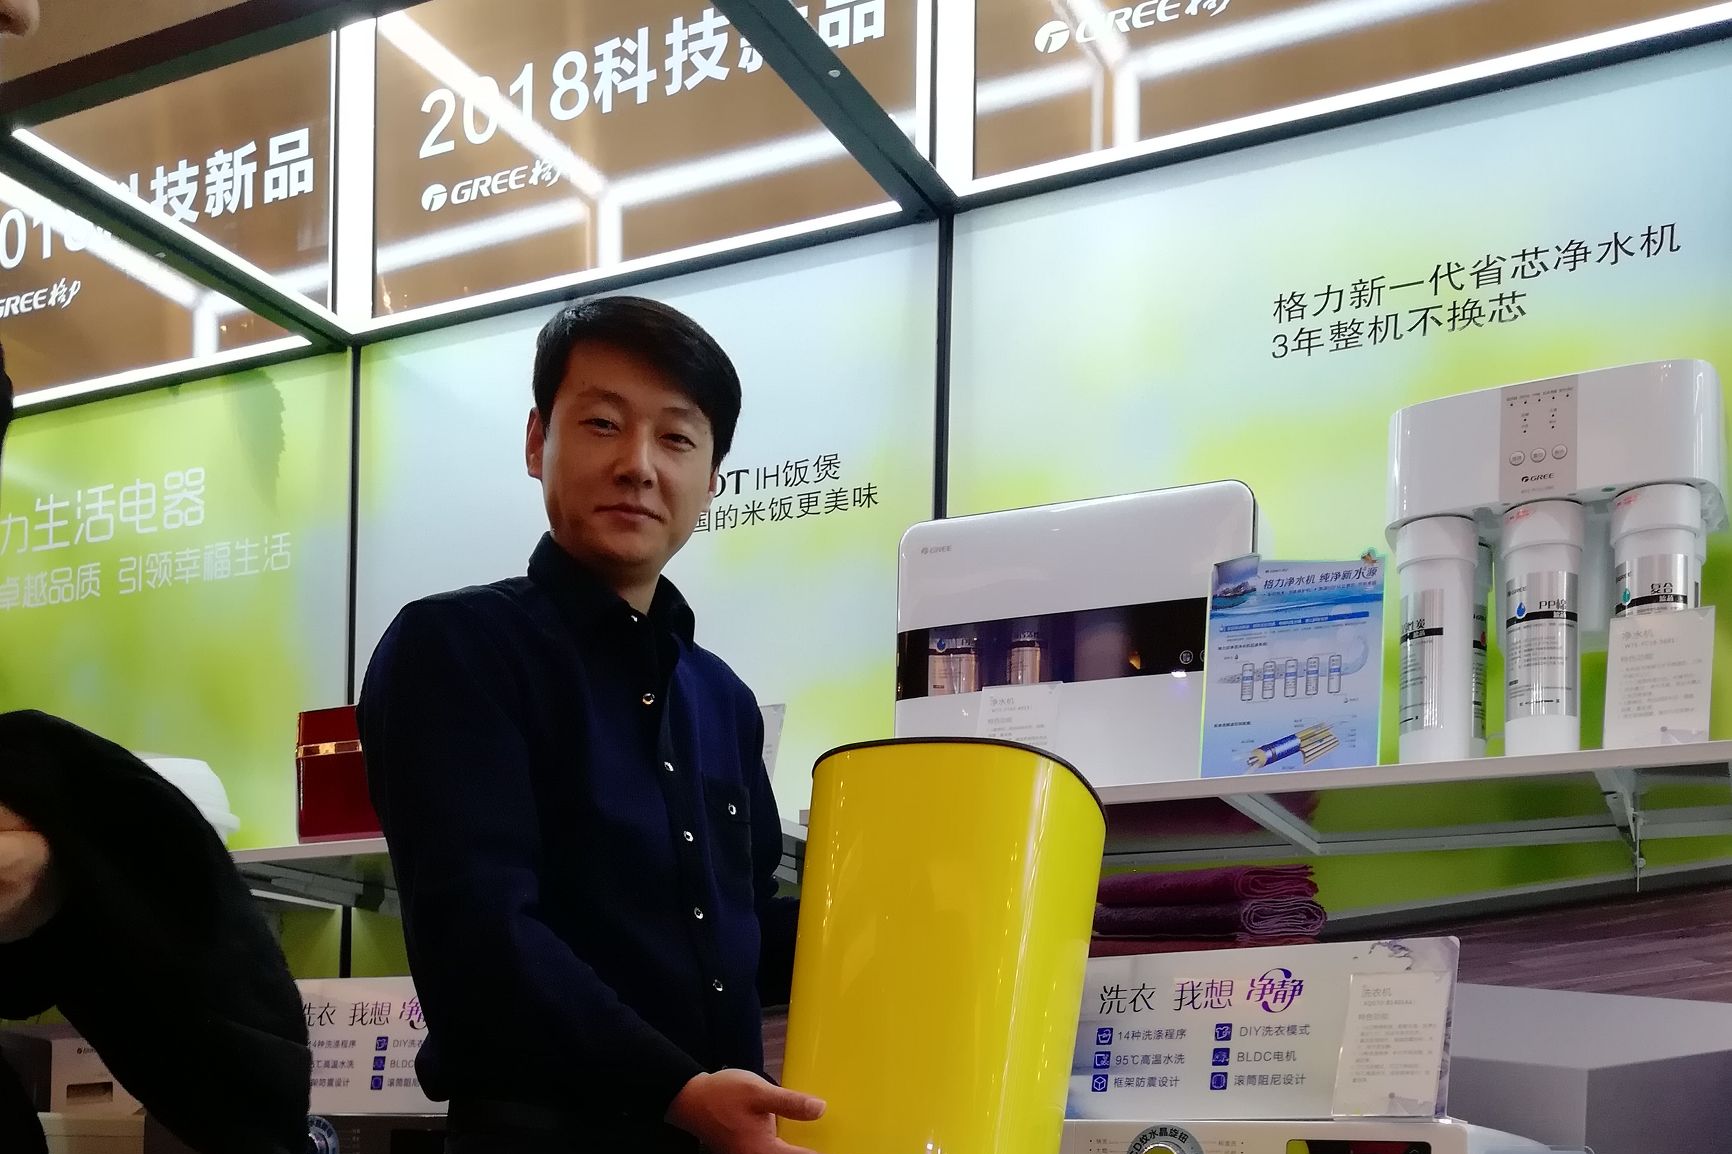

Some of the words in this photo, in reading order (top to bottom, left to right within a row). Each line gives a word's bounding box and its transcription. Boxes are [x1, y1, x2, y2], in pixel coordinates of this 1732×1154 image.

[419, 0, 885, 159] 2018科技品
[450, 164, 527, 206] GREE
[1273, 222, 1682, 324] 格力新一代省芯净水机
[1271, 290, 1527, 359] 3年整机不换芯
[0, 467, 206, 554] 力生活电器
[0, 562, 101, 611] 卓越品质
[118, 532, 291, 594] 引领幸福生活
[1263, 574, 1316, 590] 格力净水机
[1099, 983, 1156, 1014] 洗衣
[1173, 979, 1234, 1011] 我想
[1246, 967, 1304, 1014] 净静
[349, 1001, 391, 1026] 我想
[1117, 1028, 1187, 1041] 14种洗涤程序
[1239, 1024, 1311, 1038] DIY洗衣模式
[1115, 1054, 1185, 1066] 95℃高温水洗
[1236, 1051, 1297, 1063] BLDC电机
[1113, 1075, 1180, 1089] 框架防震设计
[1233, 1073, 1307, 1087] 滚筒阻尼设计
